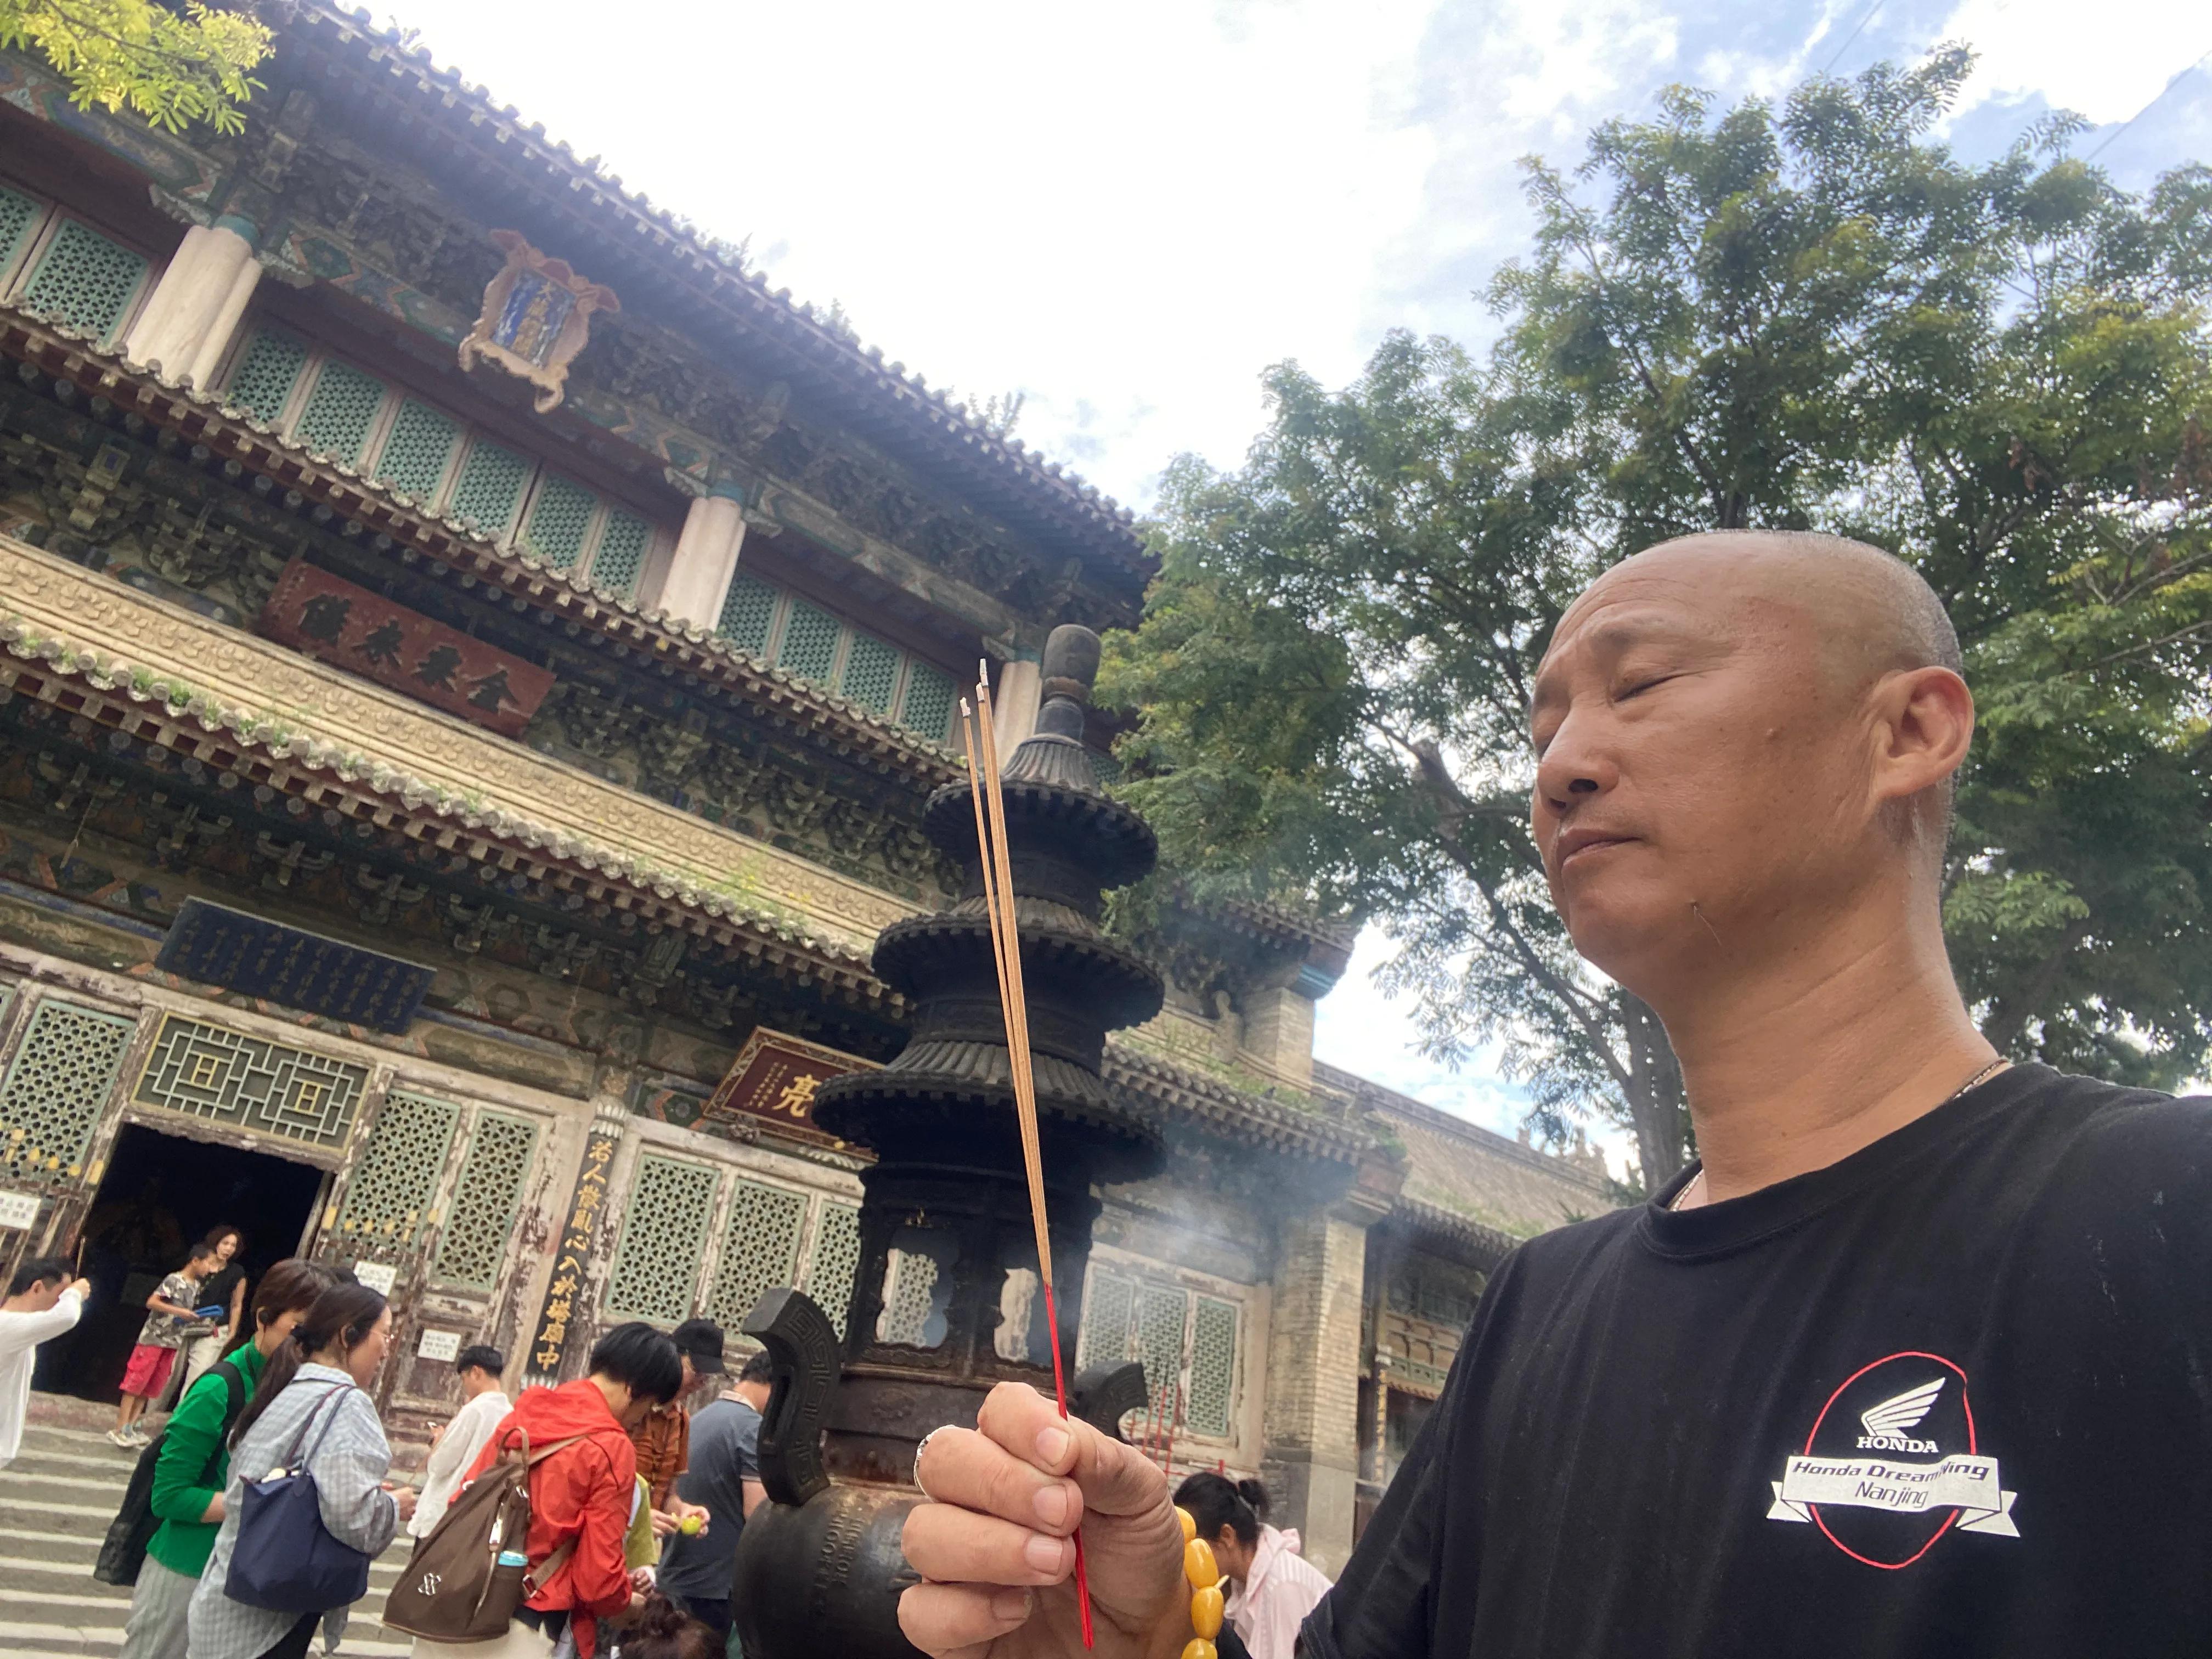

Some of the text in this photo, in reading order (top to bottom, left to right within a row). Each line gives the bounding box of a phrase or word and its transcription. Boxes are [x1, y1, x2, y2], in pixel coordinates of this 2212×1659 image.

[1857, 1436, 1939, 1453] HONDA
[1792, 1462, 1861, 1476] Honda
[1855, 1481, 1928, 1508] Nanjing
